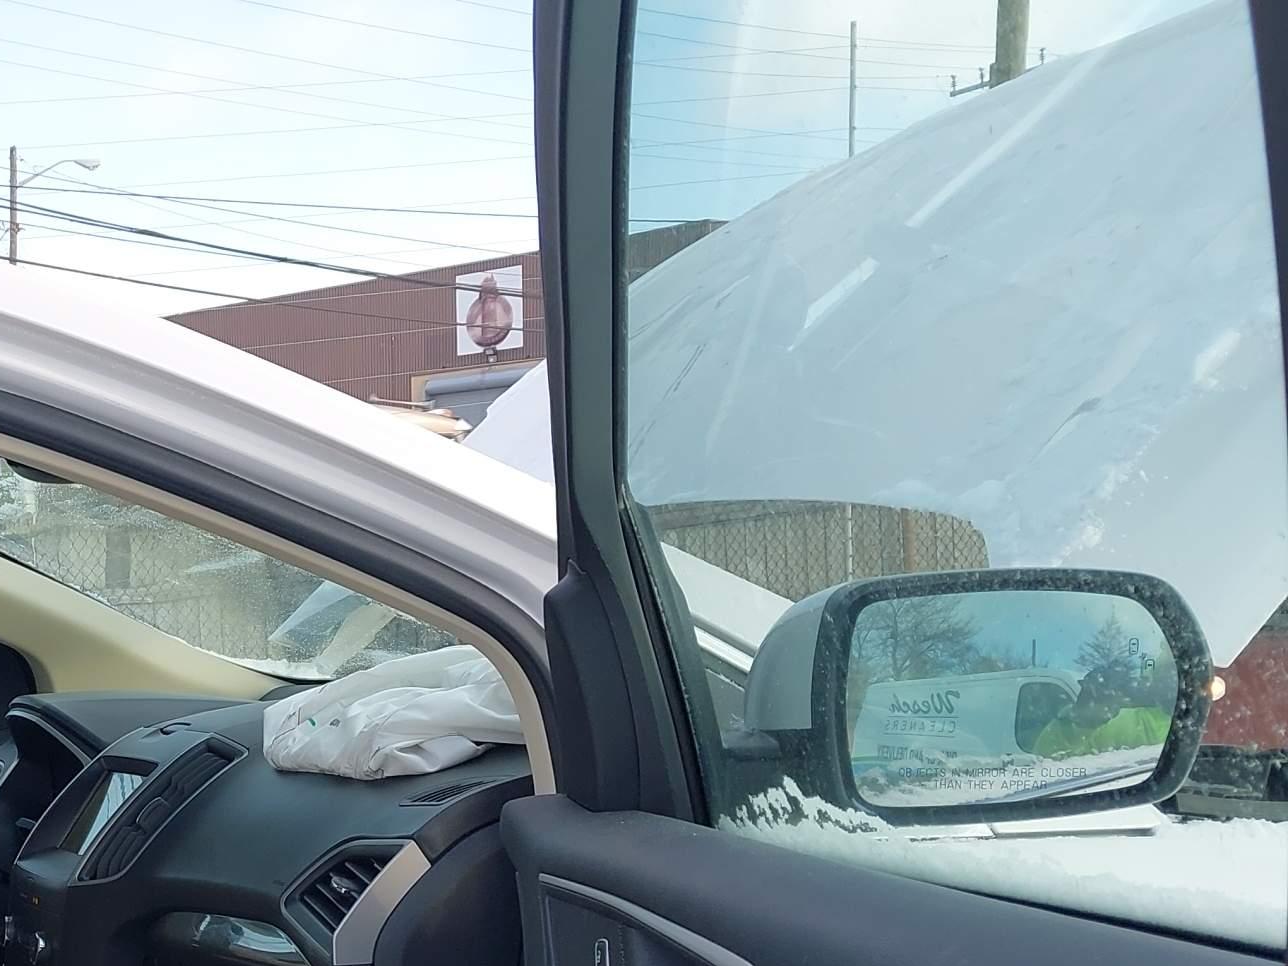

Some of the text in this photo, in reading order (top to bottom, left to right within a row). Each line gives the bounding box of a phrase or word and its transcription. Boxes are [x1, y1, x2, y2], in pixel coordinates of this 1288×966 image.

[898, 767, 1087, 778] OBJECTS IN MIRROR ARE CLOSER
[934, 779, 1048, 790] THAN THEY APPEAR
